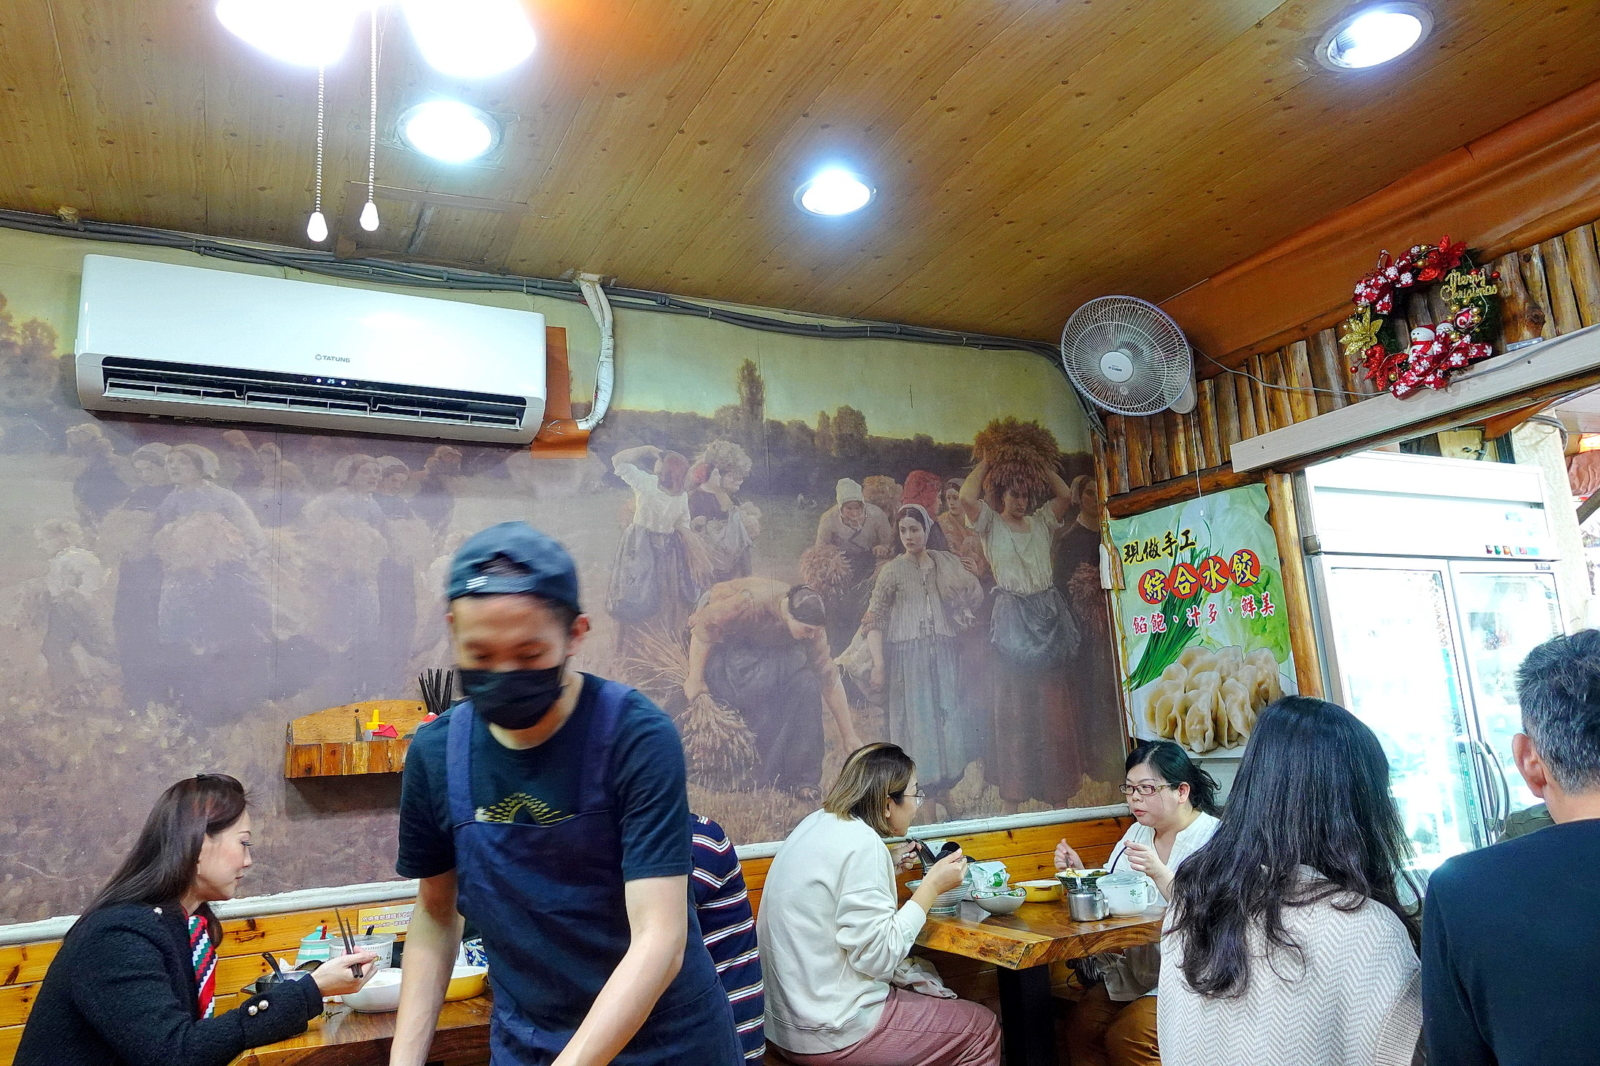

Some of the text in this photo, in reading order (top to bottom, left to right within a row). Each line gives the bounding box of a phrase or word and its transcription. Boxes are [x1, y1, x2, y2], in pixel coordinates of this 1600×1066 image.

[1444, 269, 1487, 288] Merry
[1440, 284, 1498, 302] Christmas
[322, 355, 351, 363] TATUNG
[1123, 529, 1196, 564] 現做手工
[1143, 551, 1258, 602] 綜合水餃
[1132, 592, 1275, 635] 餡飽、汁多、鮮美
